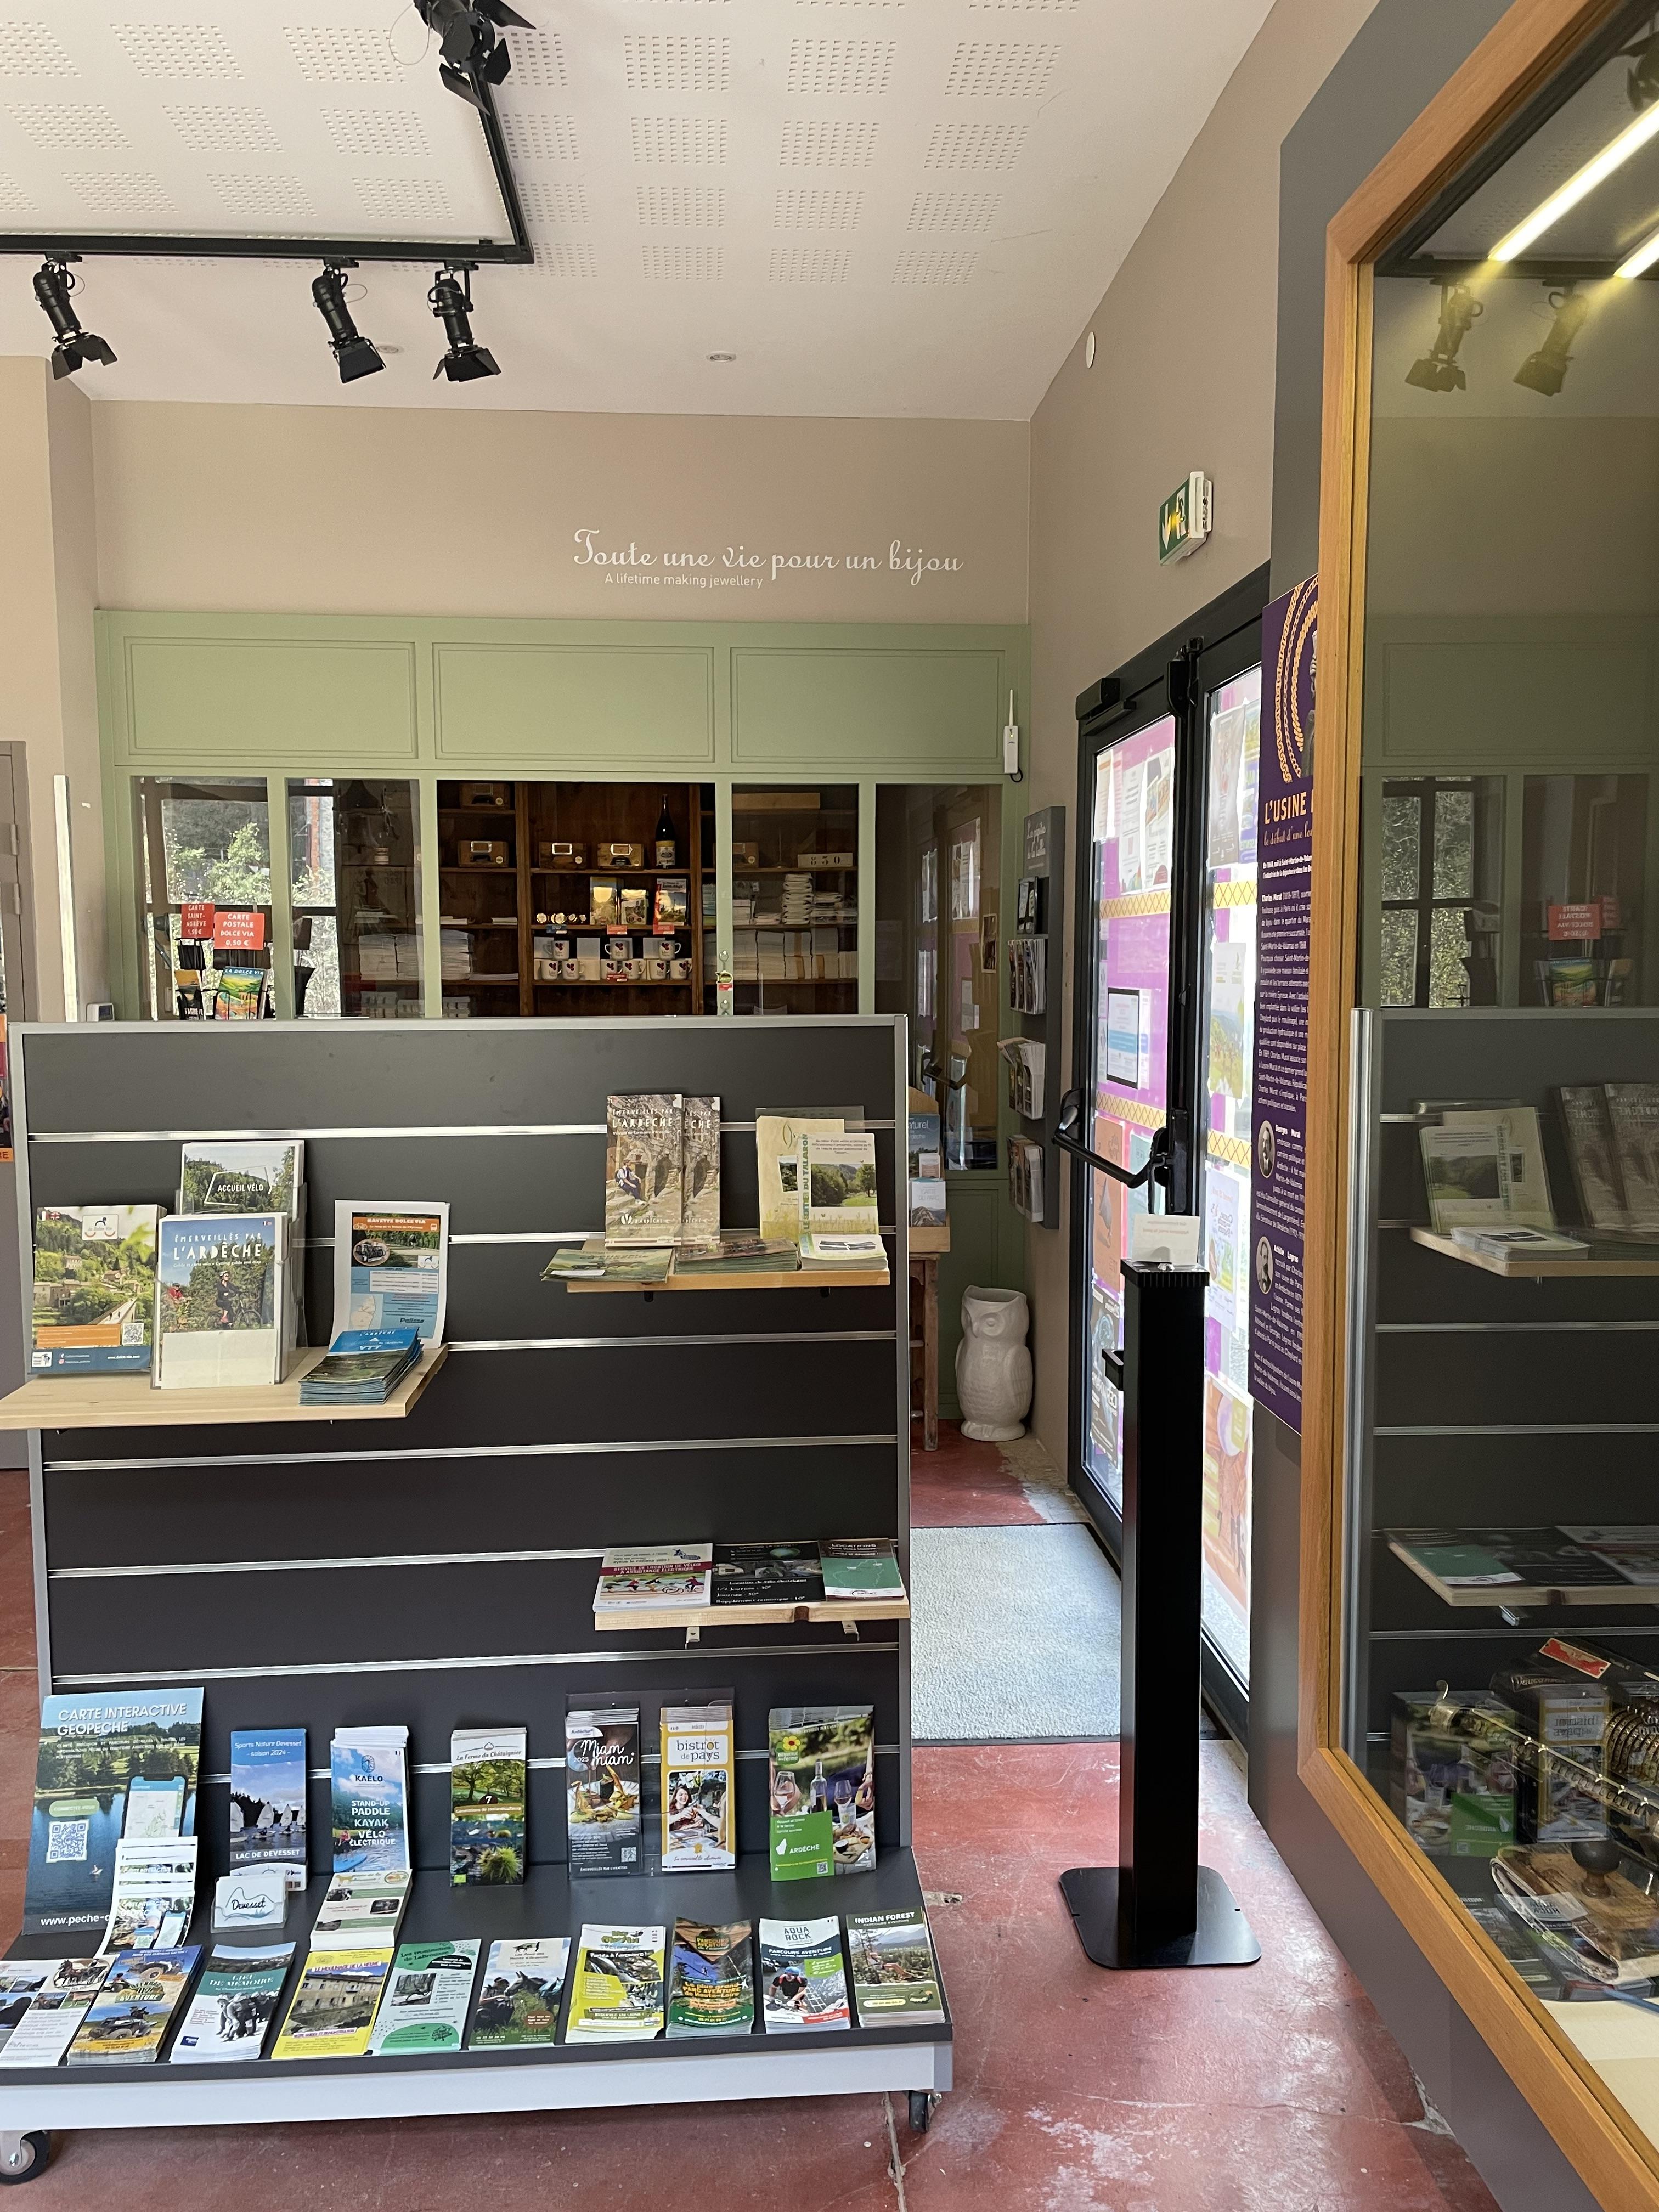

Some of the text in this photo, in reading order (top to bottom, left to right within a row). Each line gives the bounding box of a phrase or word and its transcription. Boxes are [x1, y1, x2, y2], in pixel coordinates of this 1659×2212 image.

[574, 529, 964, 586] Toute une vie pour un bijou
[605, 573, 763, 589] A lifetime making jewellery
[1265, 792, 1306, 825] L'USINE
[612, 1116, 673, 1128] L'ARDÈCHE
[174, 1242, 262, 1260] L'ARDÈCHE
[59, 1703, 187, 1721] CARTE INTERACTIVE
[57, 1721, 129, 1735] GEOPECHE
[580, 1740, 624, 1758] Miam
[676, 1740, 719, 1751] bistrot
[591, 1752, 634, 1765] miam
[691, 1752, 719, 1762] pays
[486, 1796, 492, 1804] 7
[352, 1807, 390, 1815] PADDLE
[354, 1819, 389, 1827] KAYAK
[358, 1829, 386, 1838] VÉLO
[789, 1844, 820, 1854] ARDÈCHE
[231, 1897, 266, 1910] Devesset
[886, 1912, 915, 1920] FOREST
[785, 1933, 811, 1941] ROCK
[414, 1946, 452, 1955] trottinettes
[228, 1978, 274, 1986] MÉMOIRE
